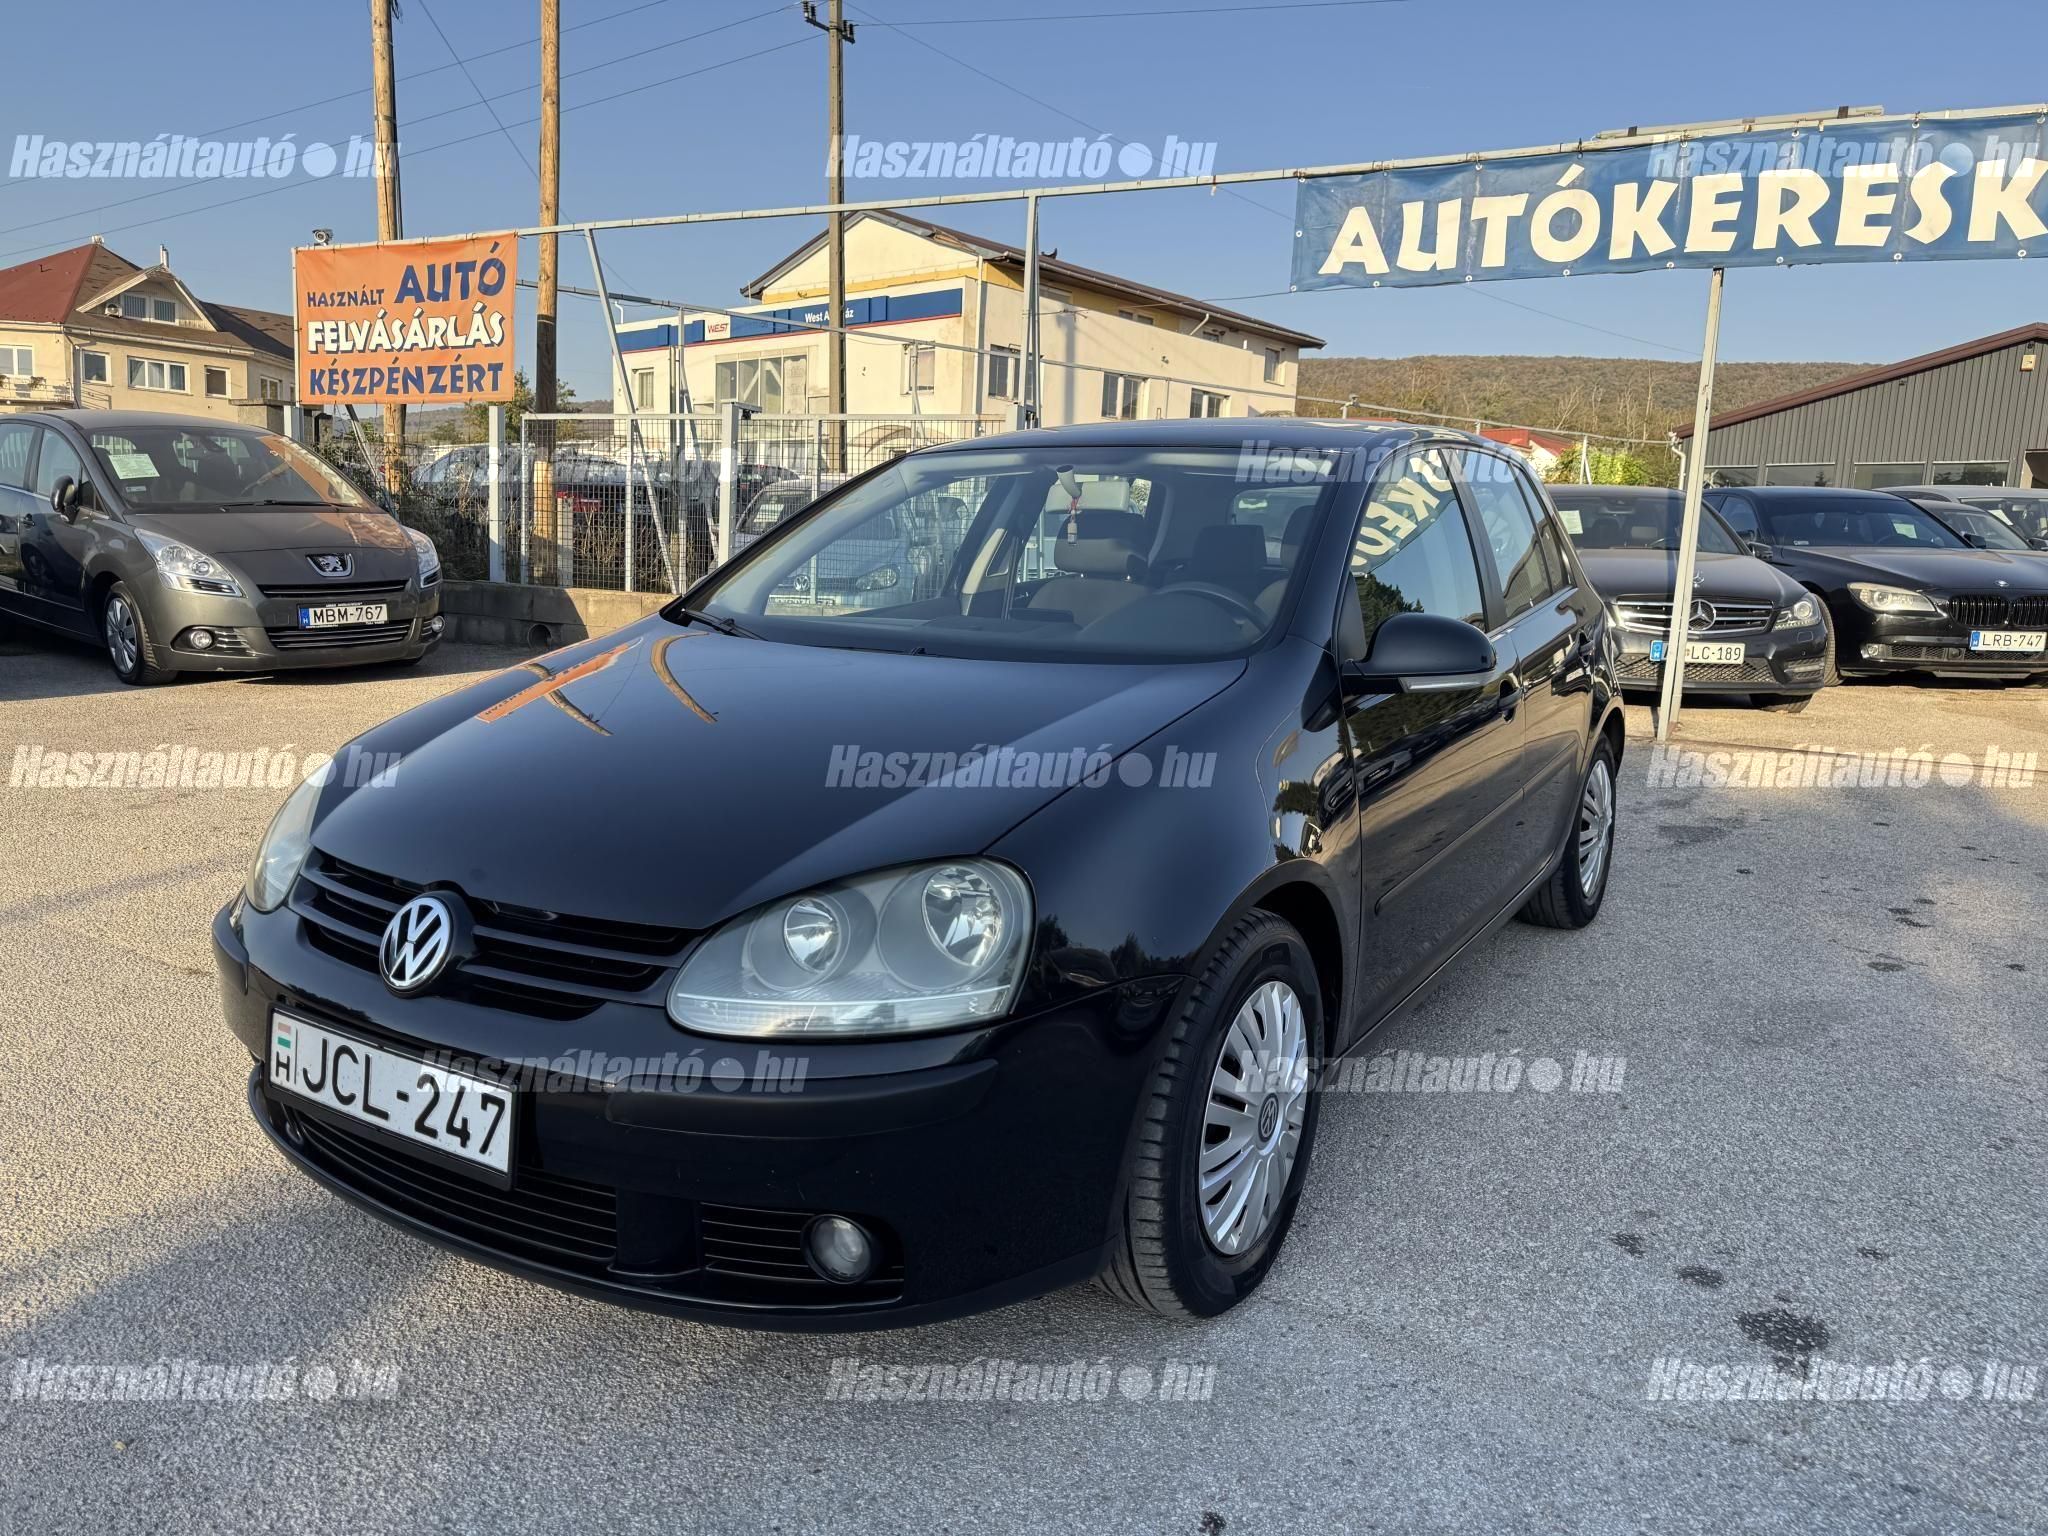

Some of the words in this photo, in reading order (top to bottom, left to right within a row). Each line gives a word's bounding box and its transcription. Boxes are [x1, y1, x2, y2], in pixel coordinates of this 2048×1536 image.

[1319, 158, 2048, 274] AUTÓKERESK
[307, 285, 384, 307] HASZNÁLT
[394, 241, 506, 303] AUTÓ
[307, 301, 505, 354] FELVÁSÁRLÁS
[708, 323, 729, 333] WEST
[805, 311, 823, 323] West
[309, 354, 503, 395] KÉSZPÉNZÉRT
[313, 605, 383, 624] MBM-767
[1691, 646, 1742, 660] LC-189
[1982, 634, 2043, 647] LRB-747
[275, 1051, 291, 1082] H
[302, 1038, 506, 1155] JCL-247
